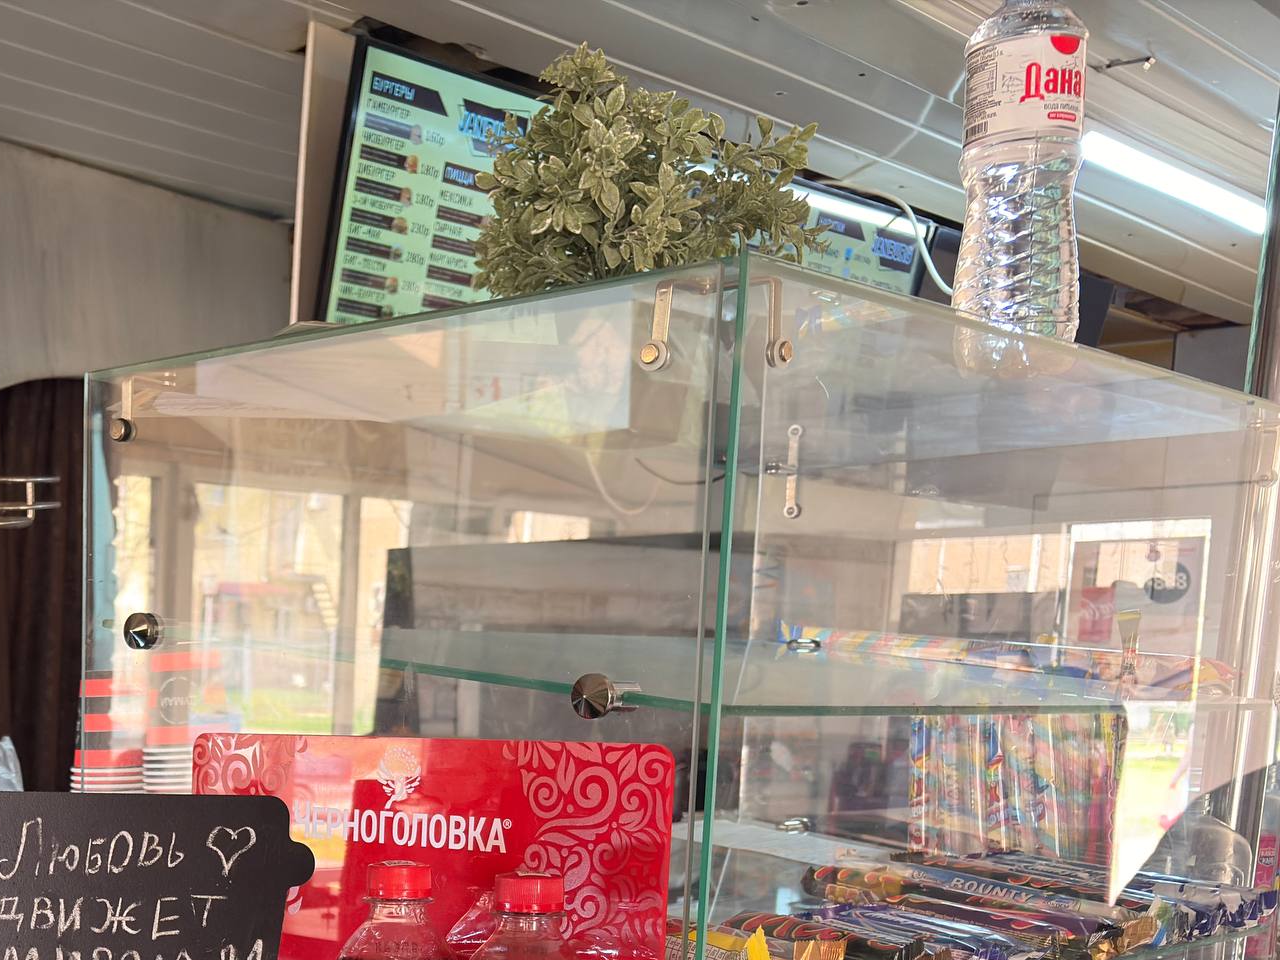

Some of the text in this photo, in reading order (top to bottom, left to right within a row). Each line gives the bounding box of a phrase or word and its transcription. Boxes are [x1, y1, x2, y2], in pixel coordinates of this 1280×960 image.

[371, 76, 416, 101] БУРГЕРЫ
[1019, 62, 1084, 103] Дана
[294, 799, 507, 854] ЧЕРНОГОЛОВКА
[949, 876, 1031, 903] BOUNTY
